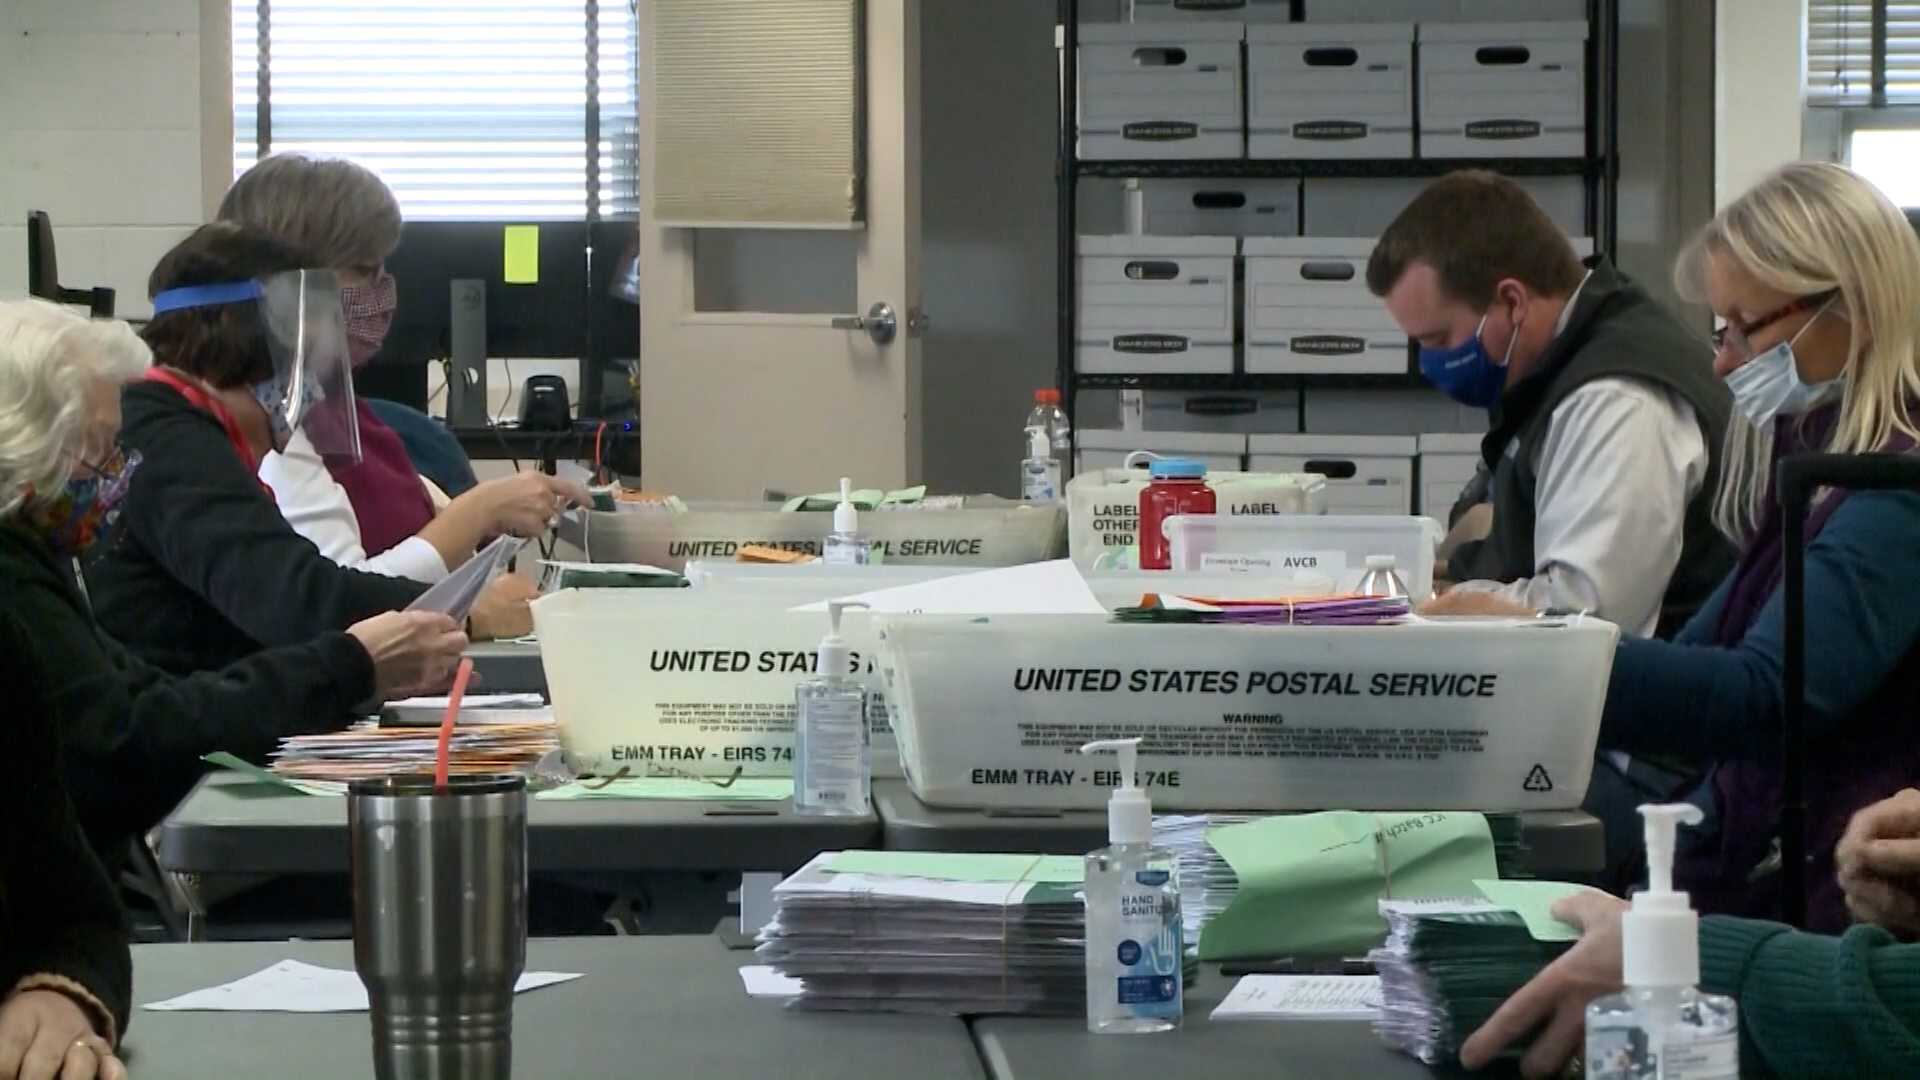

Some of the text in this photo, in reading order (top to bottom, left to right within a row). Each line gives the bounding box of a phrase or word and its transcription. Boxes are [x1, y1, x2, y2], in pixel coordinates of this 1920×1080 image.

[1231, 503, 1281, 515] LABEL
[1103, 533, 1134, 545] END
[668, 540, 737, 557] UNITED
[899, 538, 983, 556] SERVICE
[1283, 557, 1318, 568] AVCB
[649, 651, 751, 673] UNITED
[757, 651, 860, 673] STATS
[1013, 668, 1498, 697] UNITED STATES POSTAL SERVICE
[1223, 713, 1284, 725] WARNING
[612, 745, 654, 760] EMM
[658, 745, 705, 760] TRAY
[723, 746, 767, 761] EIRS
[772, 747, 795, 761] 74
[971, 769, 1017, 784] EMM
[1024, 769, 1075, 785] TRAY
[1145, 771, 1181, 787] 74E
[1121, 895, 1154, 905] HAND
